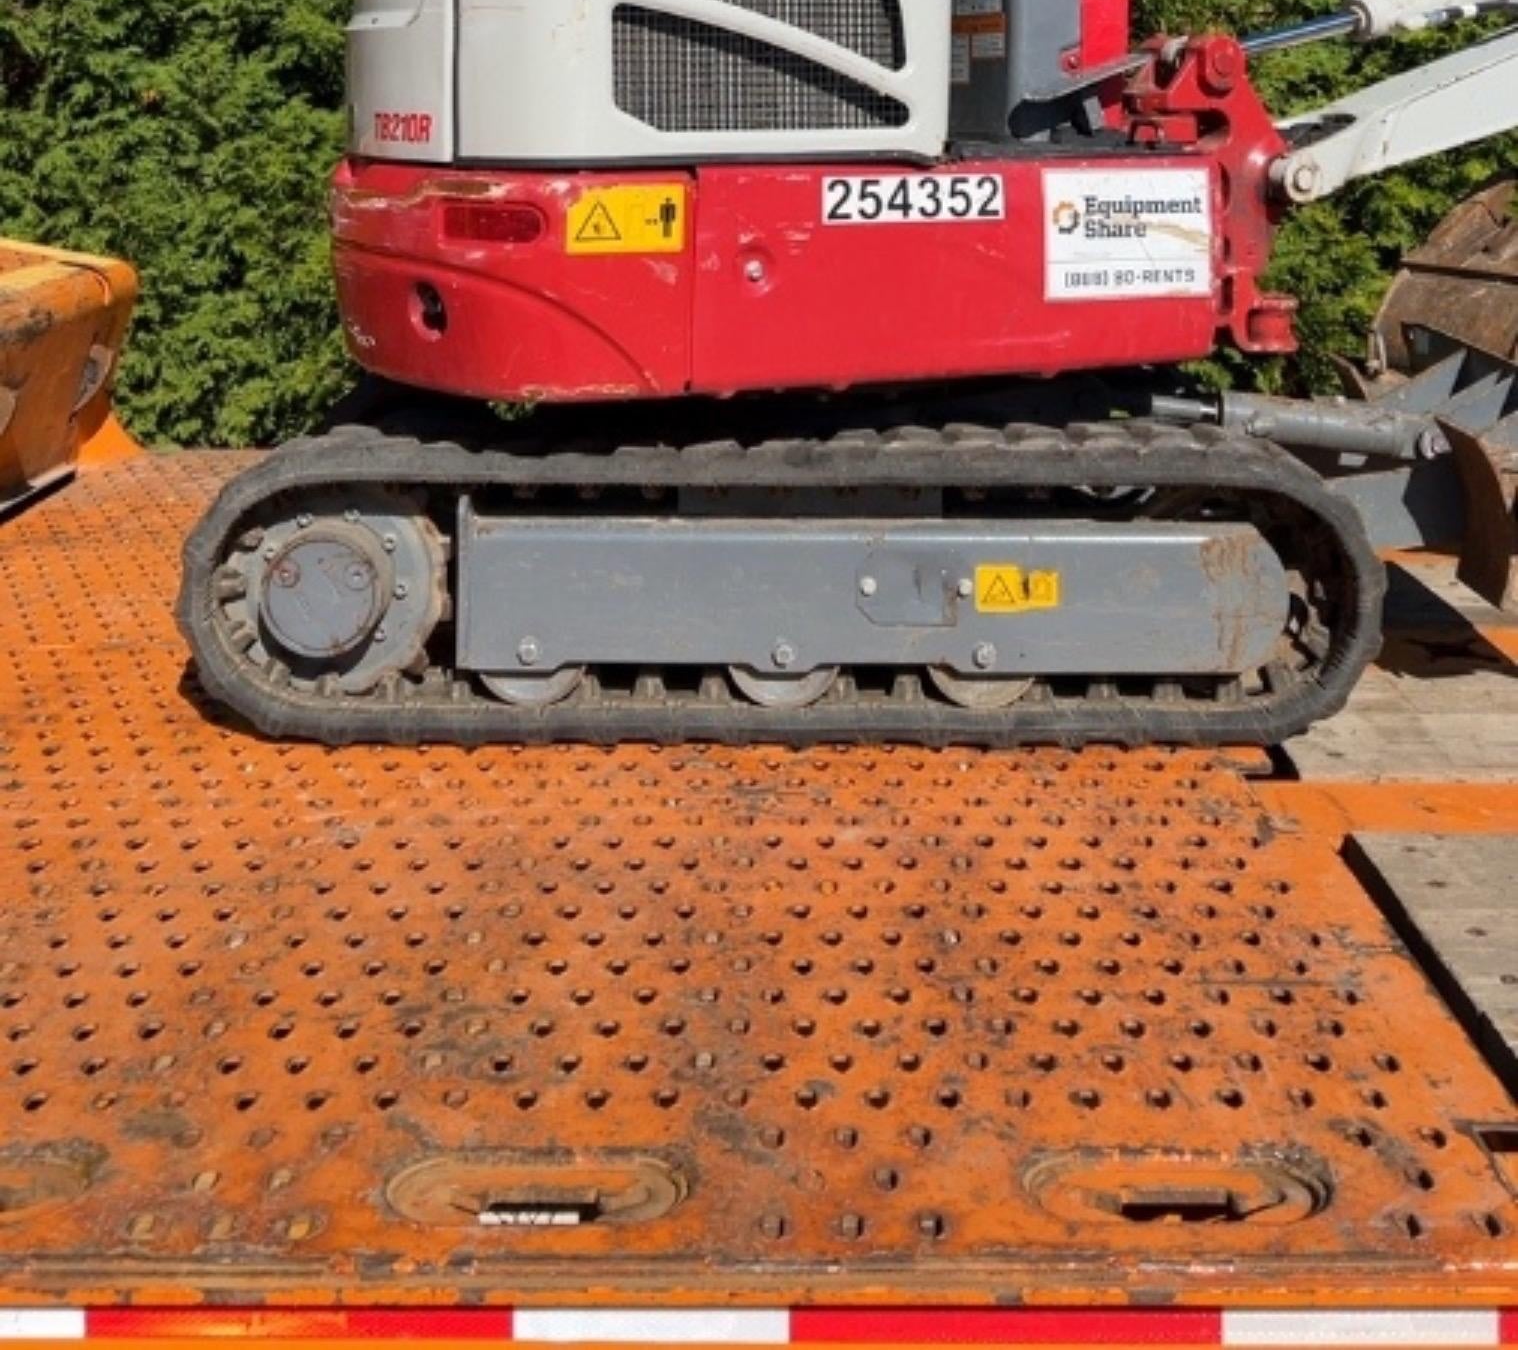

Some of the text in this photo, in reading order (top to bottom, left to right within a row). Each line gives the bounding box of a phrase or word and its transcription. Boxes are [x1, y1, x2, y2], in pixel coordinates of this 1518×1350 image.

[827, 176, 1000, 220] 254352
[1084, 195, 1202, 219] Equipment
[1085, 219, 1146, 238] Share
